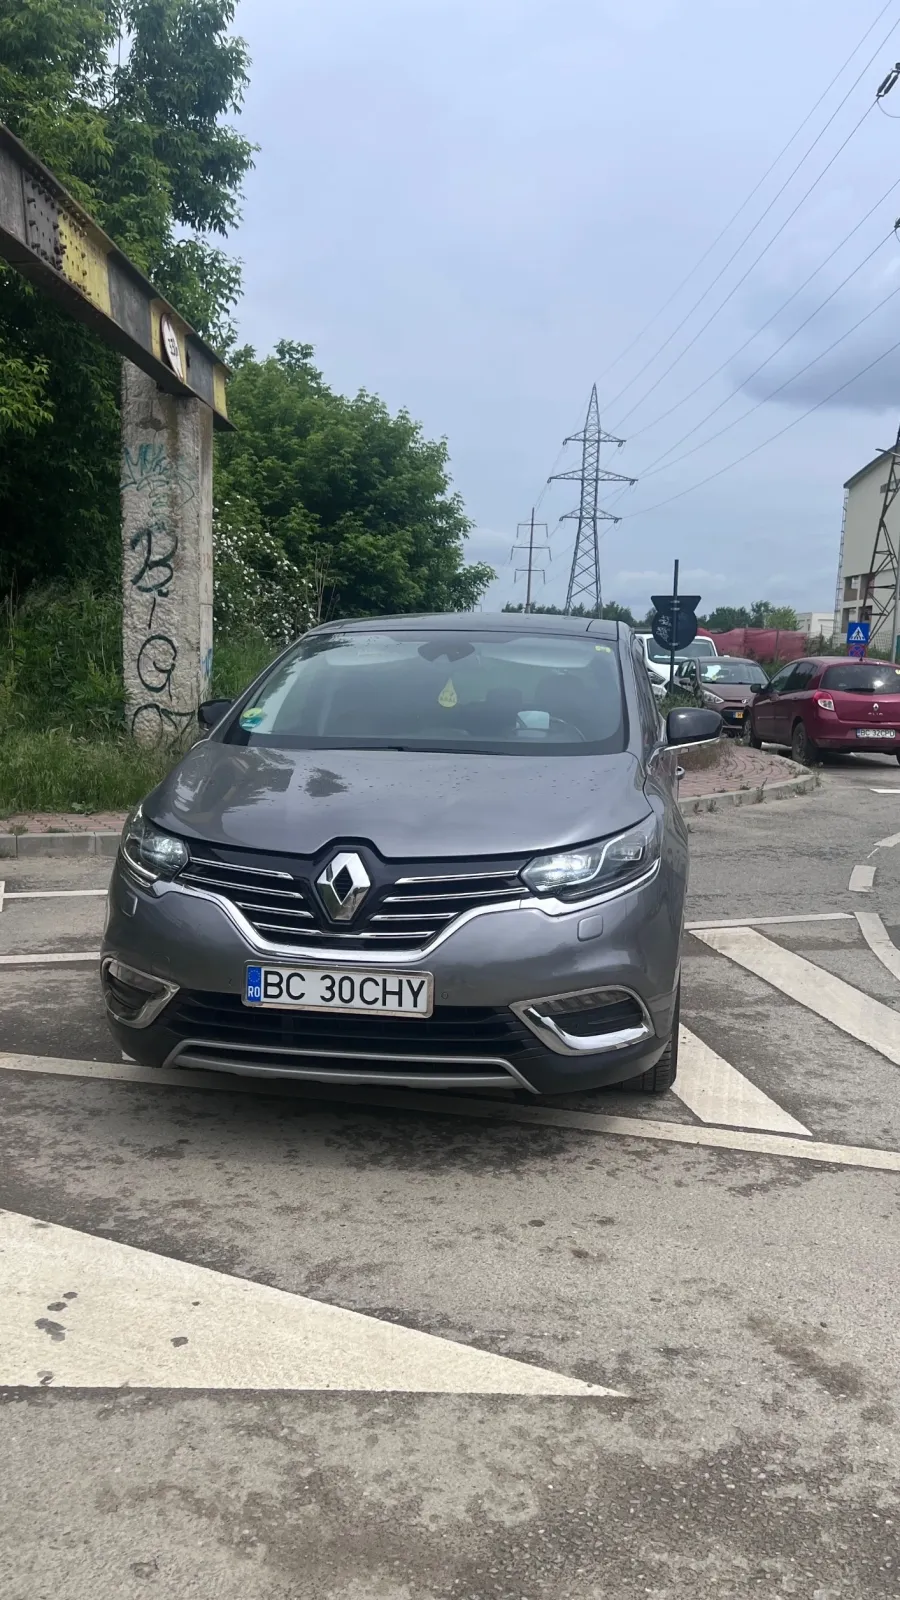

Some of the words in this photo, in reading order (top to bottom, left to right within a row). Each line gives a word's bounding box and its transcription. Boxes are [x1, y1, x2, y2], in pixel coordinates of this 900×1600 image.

[248, 986, 261, 998] RO
[263, 970, 306, 1001] BC
[320, 974, 426, 1008] 30CHY
